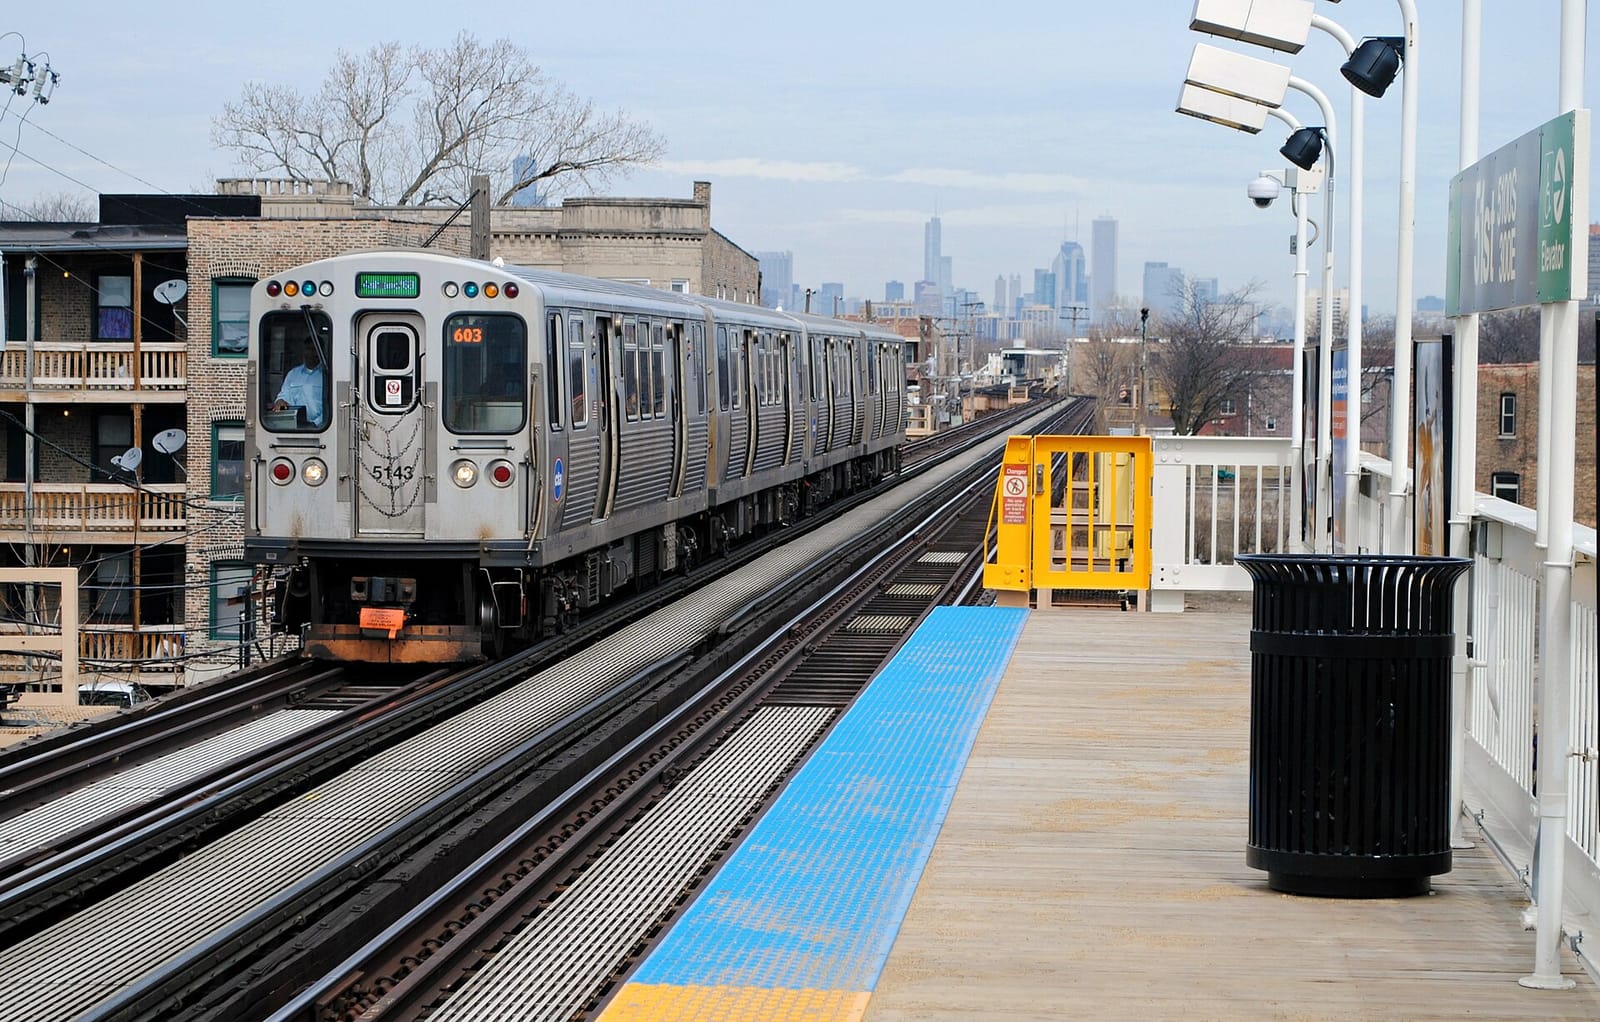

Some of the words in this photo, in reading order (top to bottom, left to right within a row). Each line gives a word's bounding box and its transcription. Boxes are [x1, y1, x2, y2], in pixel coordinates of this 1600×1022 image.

[1473, 179, 1496, 286] 51st
[1541, 239, 1565, 272] Elevator
[453, 328, 482, 343] 603
[372, 465, 414, 480] 5143
